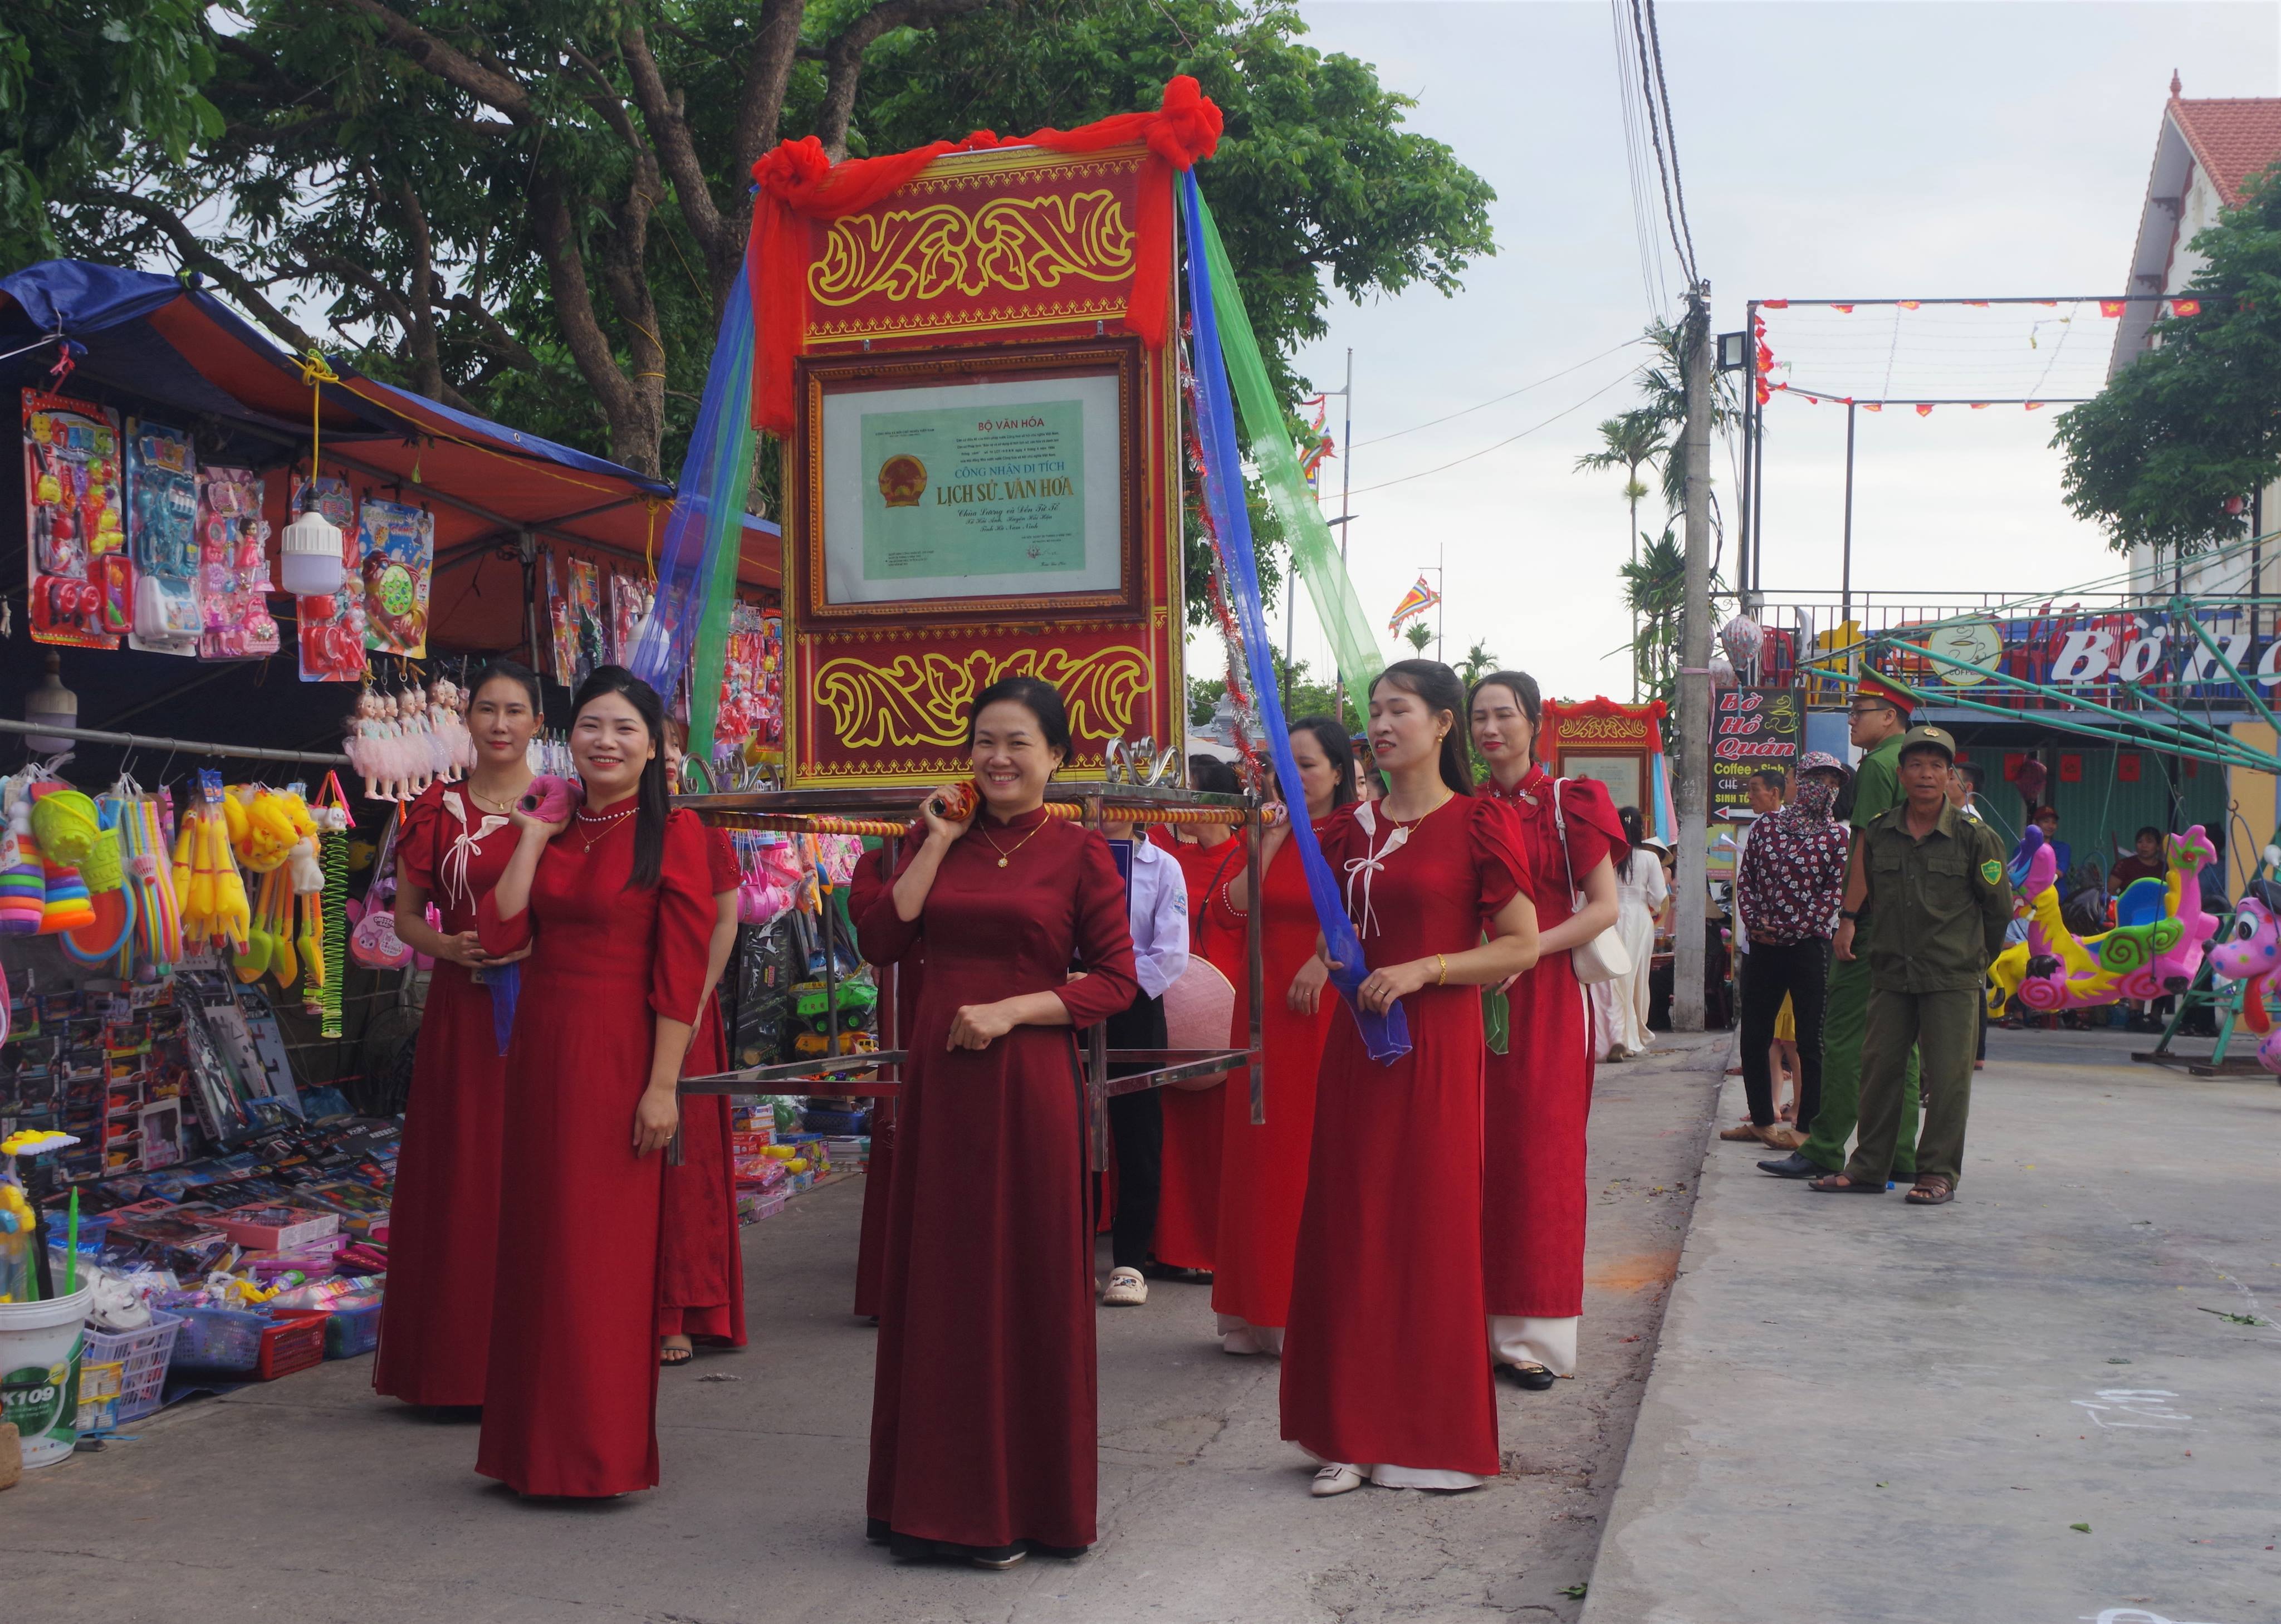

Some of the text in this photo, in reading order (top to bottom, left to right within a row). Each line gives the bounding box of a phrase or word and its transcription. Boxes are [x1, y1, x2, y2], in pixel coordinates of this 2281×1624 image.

[978, 416, 1044, 432] BỘ VĂN HÓA
[955, 460, 1064, 478] CÔNG NHẬN DI TÍCH
[937, 484, 974, 506] LỊCH
[977, 479, 998, 502] SỬ
[1004, 477, 1036, 500] VĂN
[1040, 476, 1074, 497] HÓA
[1719, 714, 1763, 735] Hồ
[1715, 737, 1796, 761] Quán
[1714, 762, 1751, 775] Coffee
[1718, 777, 1738, 790] CHÈ
[1715, 794, 1736, 803] SINH
